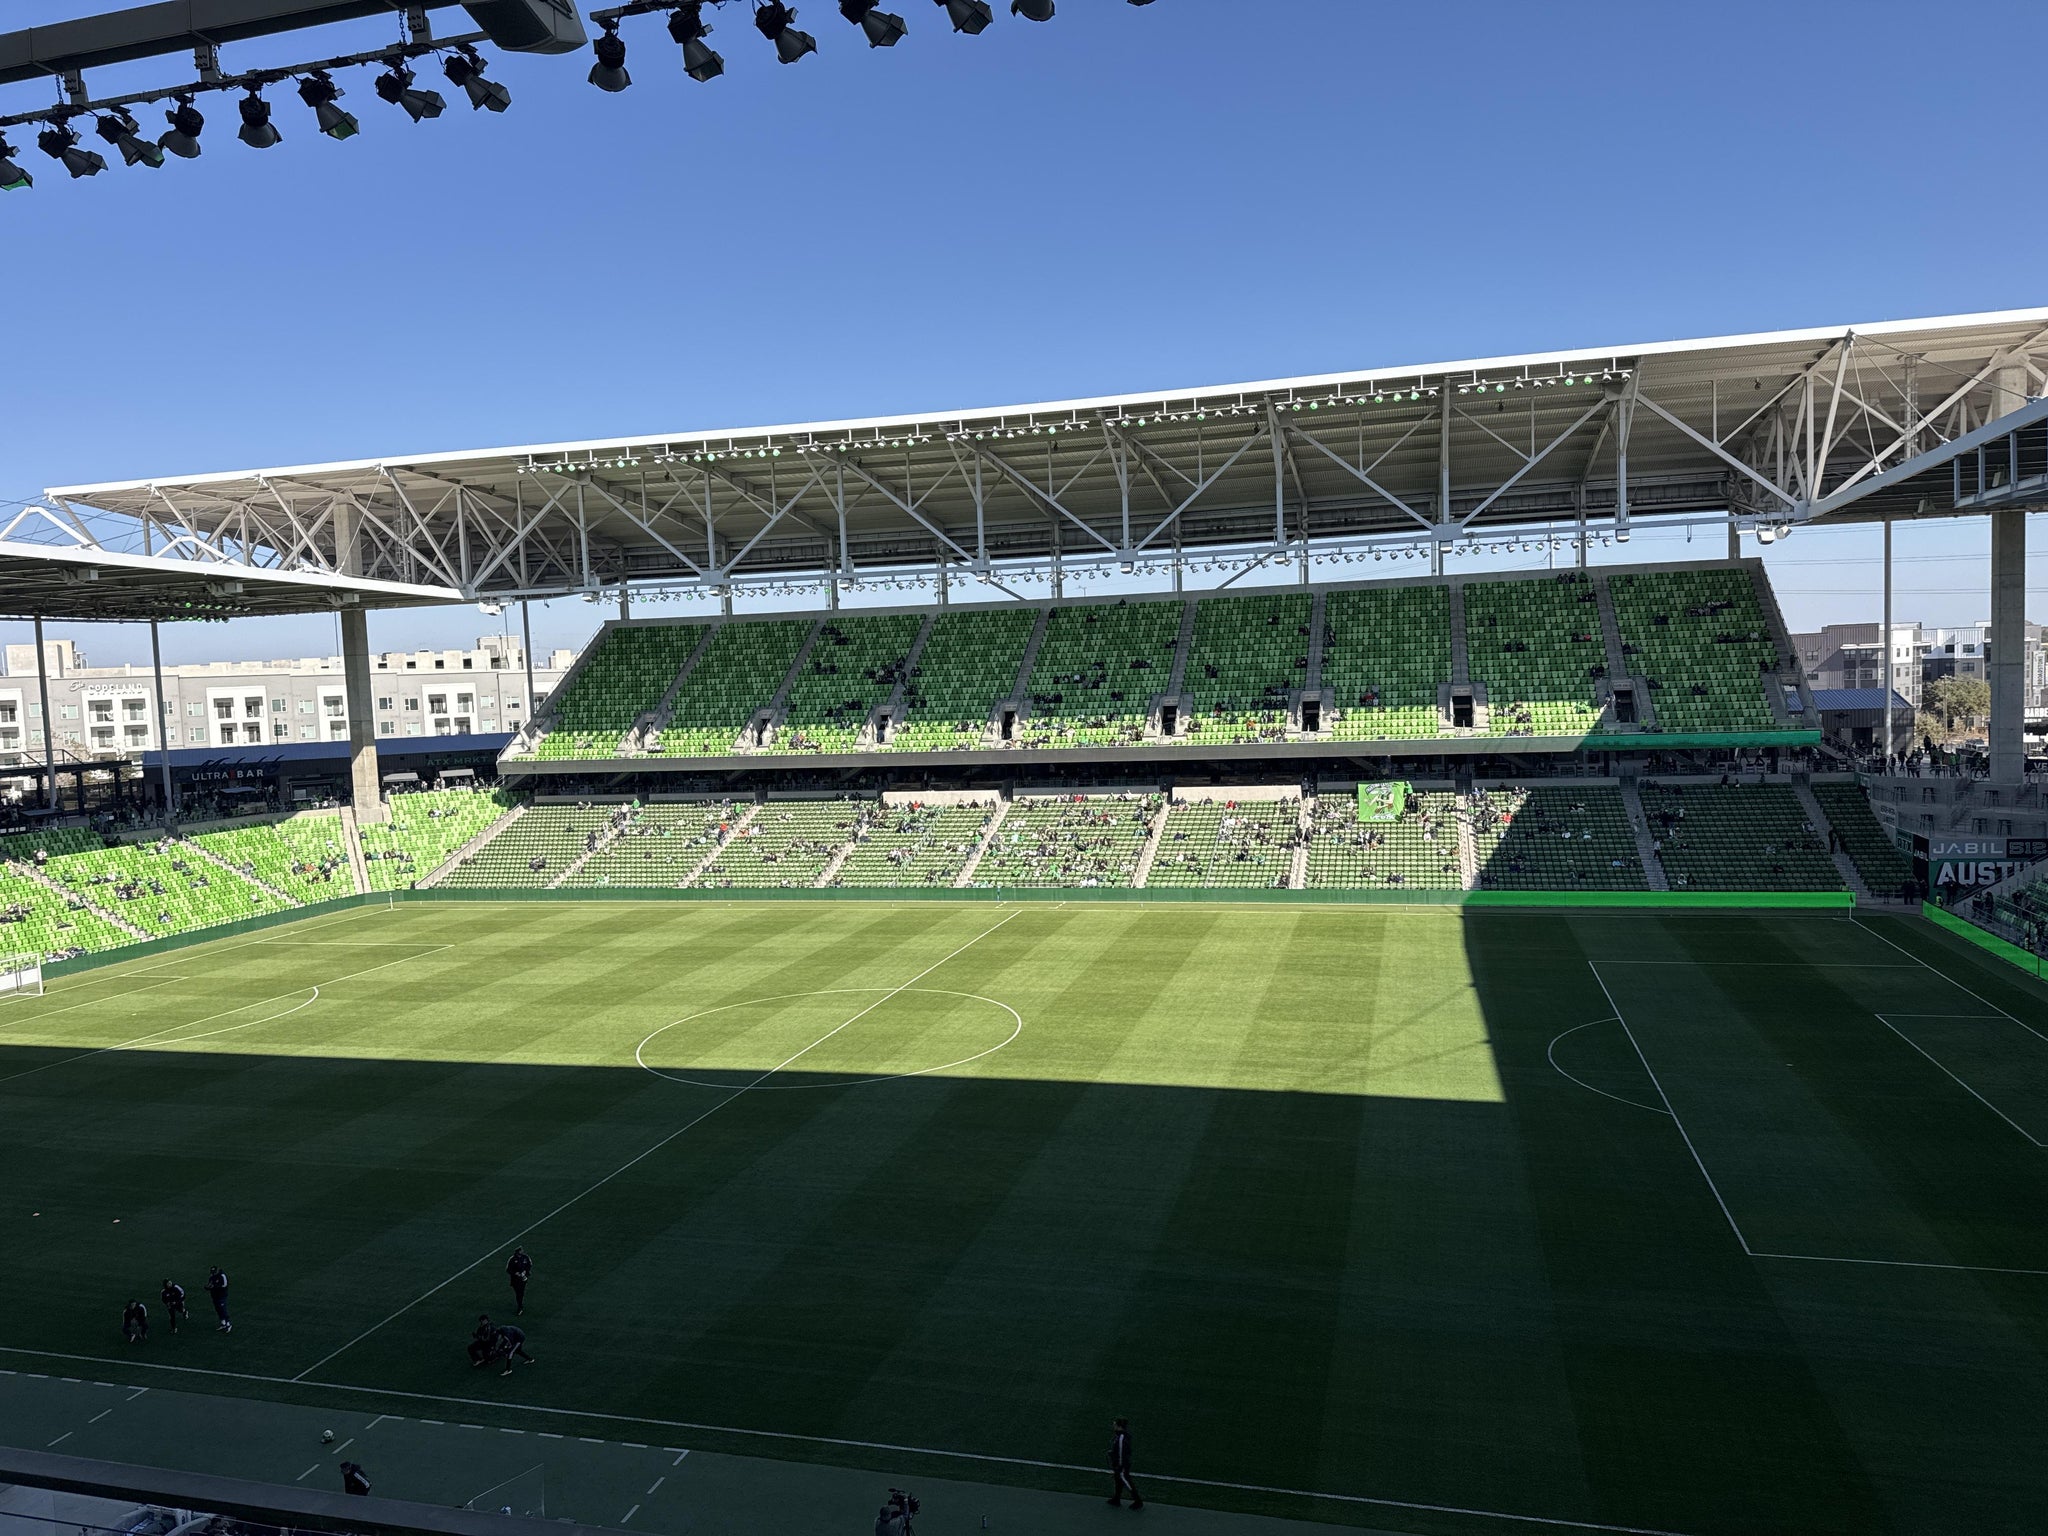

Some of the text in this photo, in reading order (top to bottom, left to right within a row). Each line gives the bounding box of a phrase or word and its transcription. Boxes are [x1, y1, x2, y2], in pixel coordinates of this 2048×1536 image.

[88, 682, 143, 695] COPELAND
[454, 756, 489, 765] MRKT
[191, 769, 264, 781] ULTRA BAR
[1932, 842, 2004, 854] JABIL
[2009, 841, 2047, 855] 512
